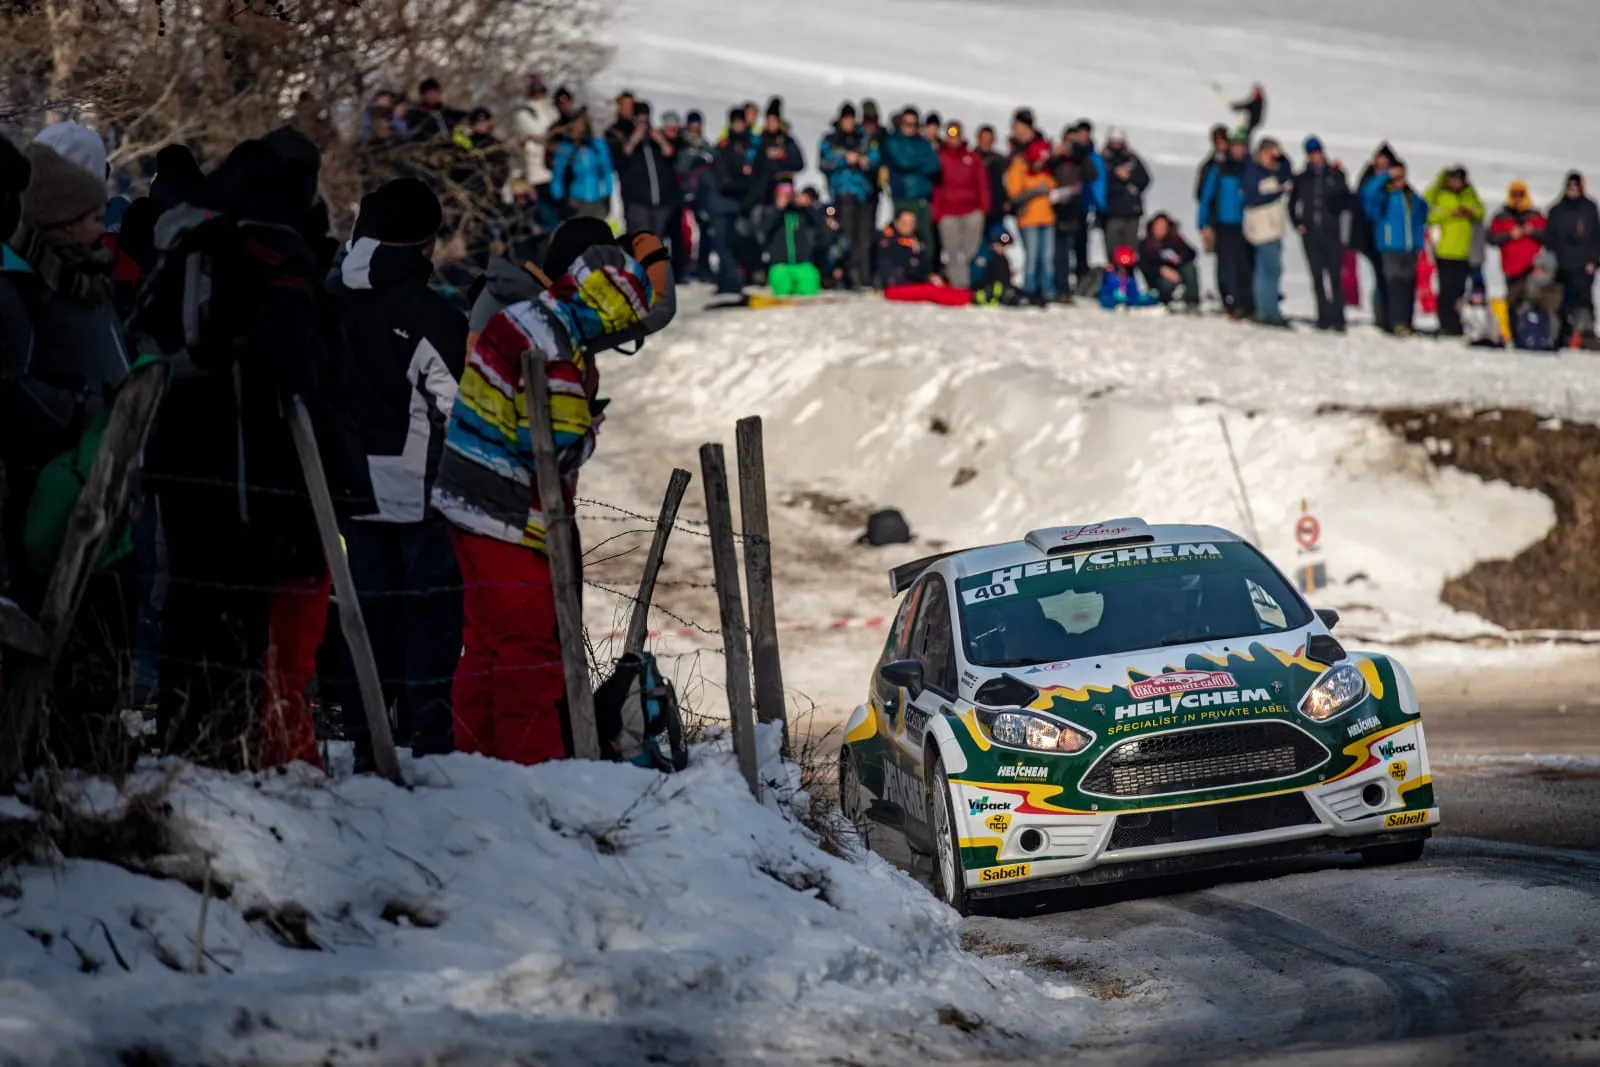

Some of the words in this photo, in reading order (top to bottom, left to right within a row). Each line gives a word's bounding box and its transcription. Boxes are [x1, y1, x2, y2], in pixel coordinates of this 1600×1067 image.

[1086, 559, 1147, 571] CLEANERS
[974, 583, 1006, 600] 40
[1135, 684, 1167, 698] RALLYE
[1107, 715, 1179, 736] SPECIALIST
[1184, 713, 1196, 722] IN
[1201, 707, 1250, 720] PRIVATE
[1254, 704, 1290, 713] LABEL
[968, 798, 1012, 812] Vipack
[1387, 811, 1425, 826] Sabelt
[983, 865, 1026, 881] Sabelt
